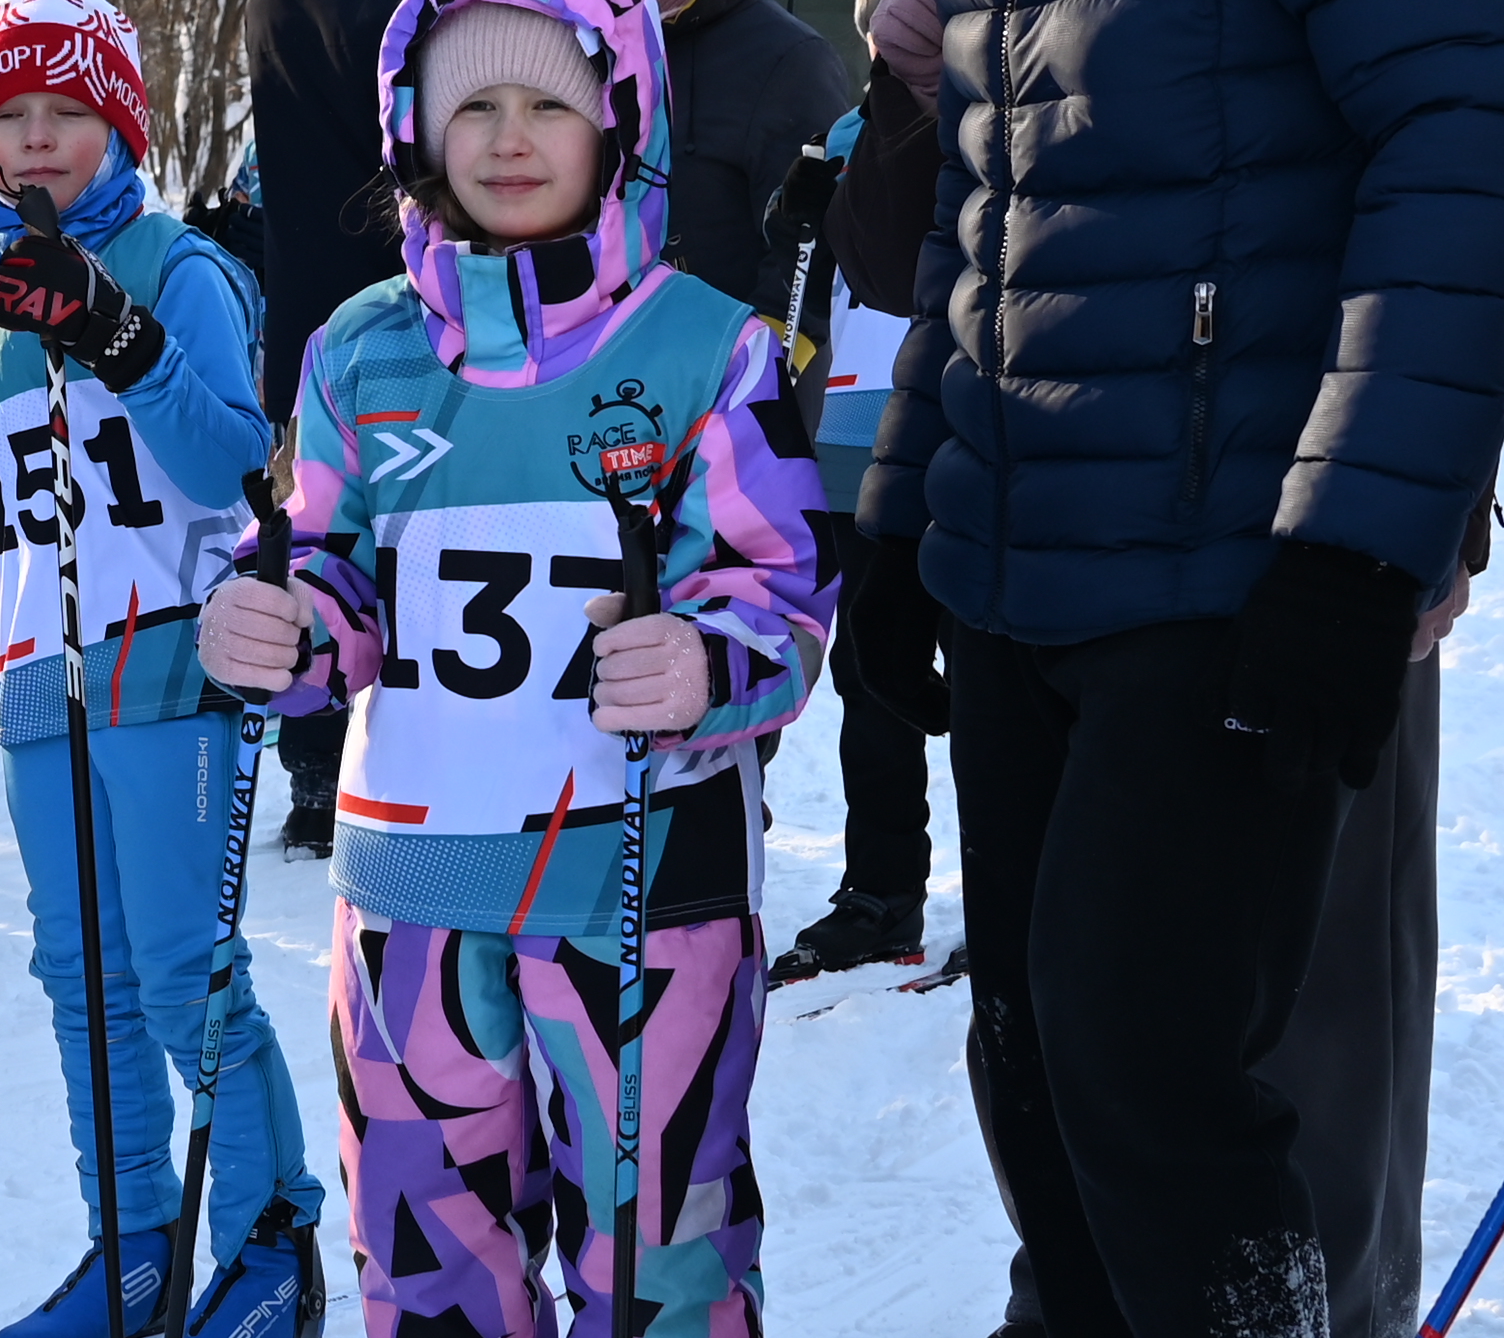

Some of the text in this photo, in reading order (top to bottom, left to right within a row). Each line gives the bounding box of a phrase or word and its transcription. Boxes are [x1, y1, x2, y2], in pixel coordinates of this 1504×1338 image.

[783, 274, 803, 343] NORDWAY
[567, 422, 637, 456] RACE
[607, 444, 654, 469] TIME
[375, 546, 627, 700] 137
[196, 736, 209, 823] NORDSKI
[217, 768, 255, 927] NORDWAY
[620, 788, 643, 967] NORDWAY
[204, 1017, 221, 1062] BLISS
[623, 1072, 637, 1122] BLISS
